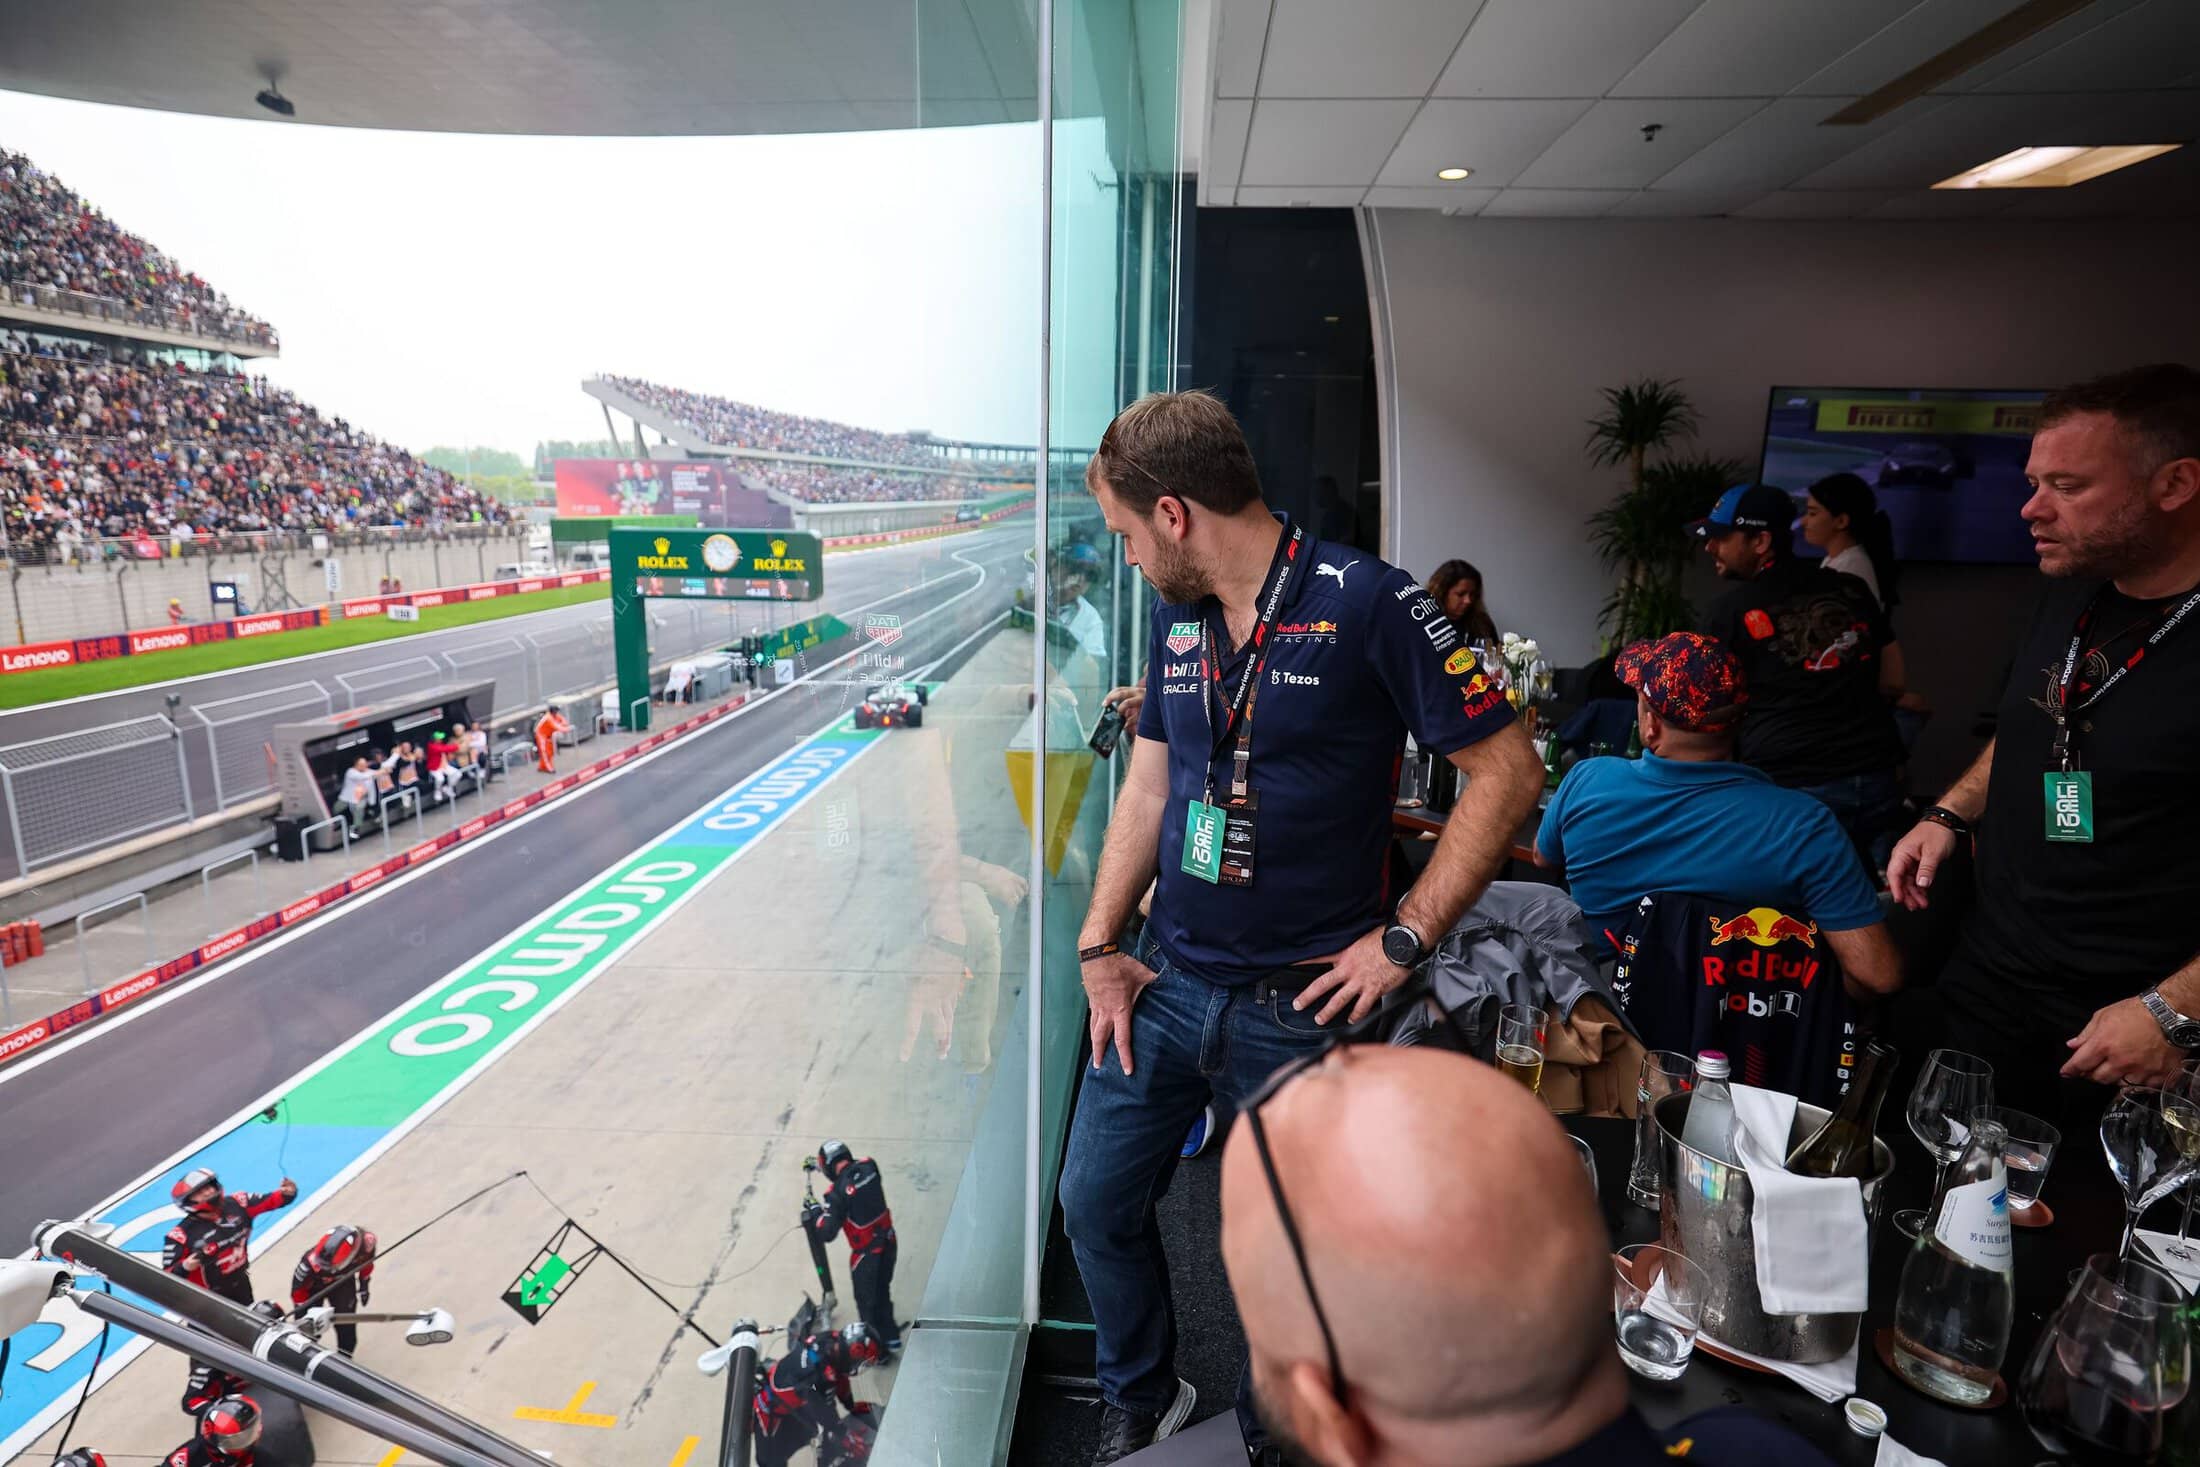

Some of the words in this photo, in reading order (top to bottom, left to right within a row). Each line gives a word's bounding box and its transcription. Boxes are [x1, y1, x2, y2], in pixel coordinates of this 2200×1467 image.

[637, 556, 689, 570] ROLEX
[753, 558, 805, 571] ROLEX
[413, 595, 443, 608] Lenovo
[1263, 565, 1289, 623] Experiences
[345, 602, 381, 618] Lenovo
[236, 618, 282, 636] Lenovo
[1175, 625, 1200, 635] TAG
[133, 632, 188, 652] Lenovo
[1273, 636, 1337, 644] RACING
[2, 648, 70, 671] Lenovo
[1163, 683, 1198, 695] ORACLE
[1283, 672, 1320, 686] Tezos
[703, 747, 846, 831] aramco
[409, 843, 438, 862] Lenovo
[351, 869, 383, 889] Lenovo
[282, 899, 320, 922] Lenovo
[203, 933, 246, 959] Lenovo
[388, 861, 698, 1057] aramco
[1703, 949, 1760, 986] Rd
[104, 975, 156, 1006] Lenovo
[0, 1026, 46, 1057] enovo
